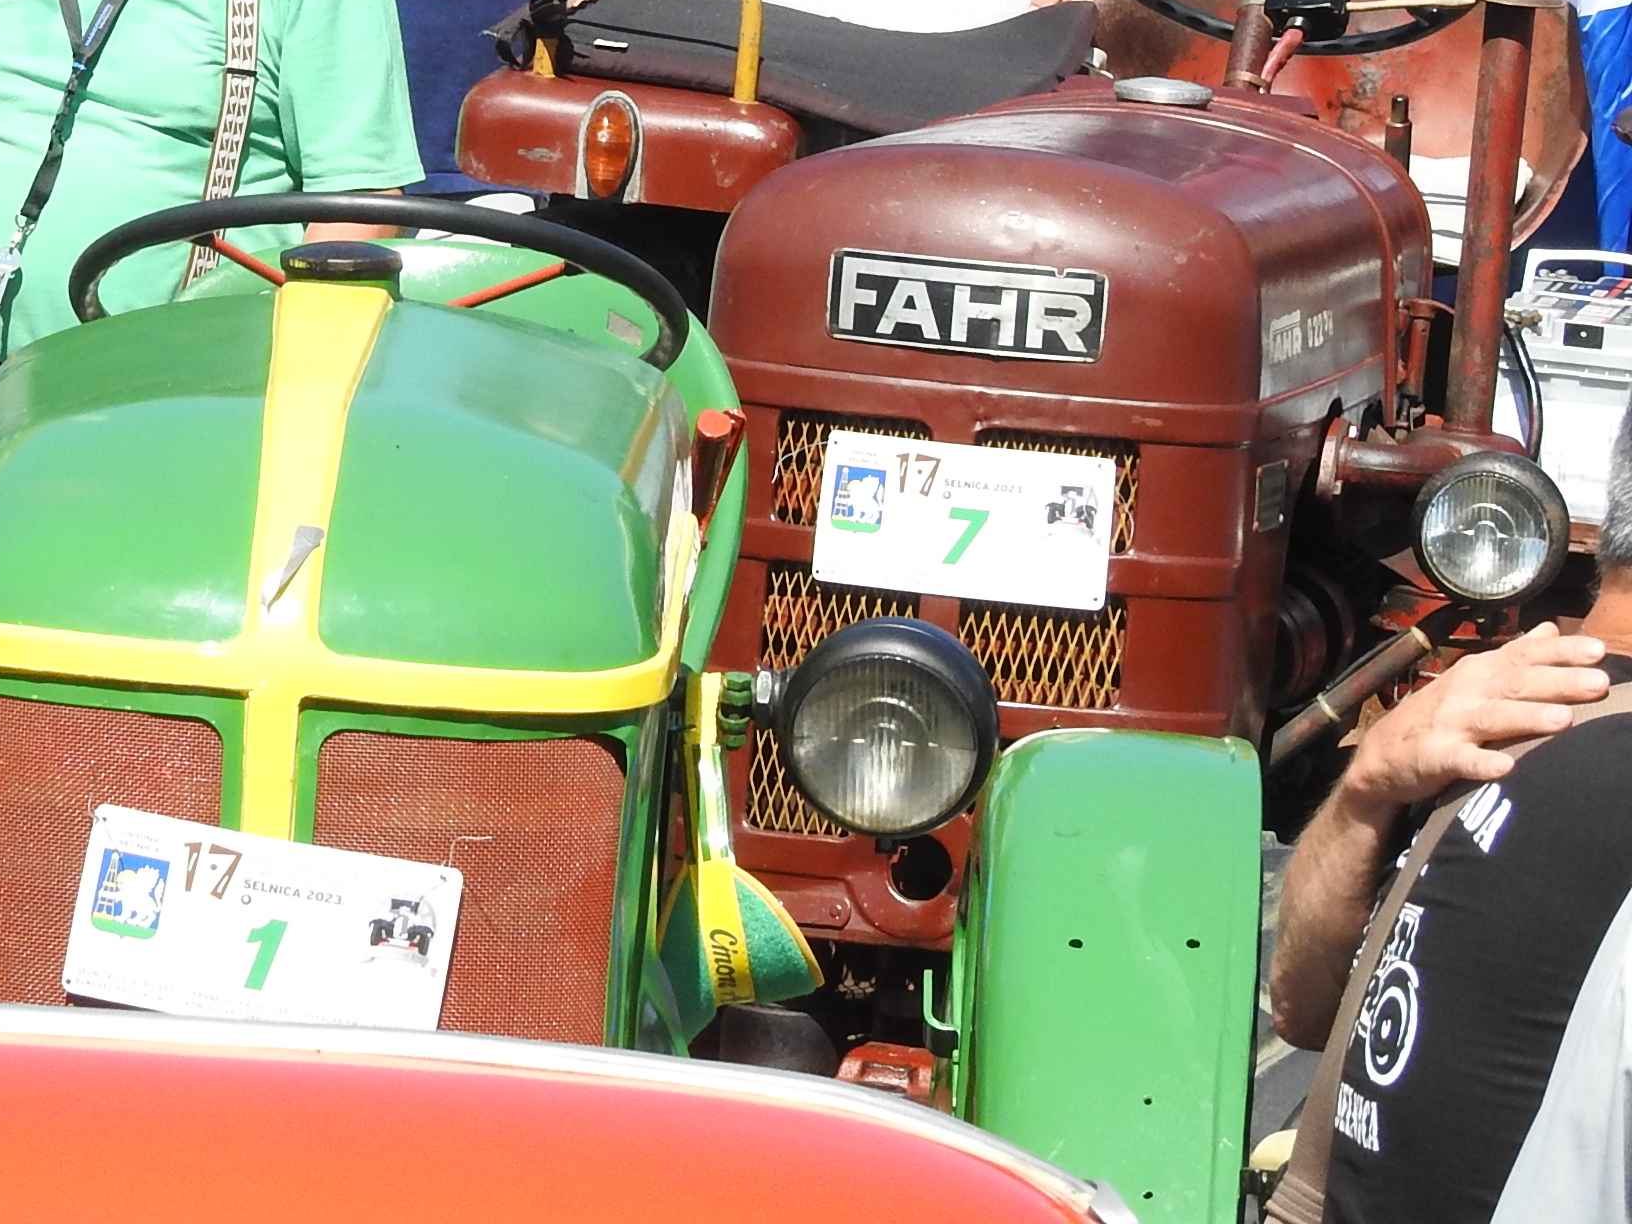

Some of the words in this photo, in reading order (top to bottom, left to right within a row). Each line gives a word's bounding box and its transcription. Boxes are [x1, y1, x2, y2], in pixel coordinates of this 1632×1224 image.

[838, 256, 1095, 353] FAHR
[943, 478, 990, 491] SELNICA
[942, 506, 991, 565] 7
[243, 878, 301, 899] SELNICA
[306, 890, 343, 906] 2023
[244, 918, 289, 991] 1
